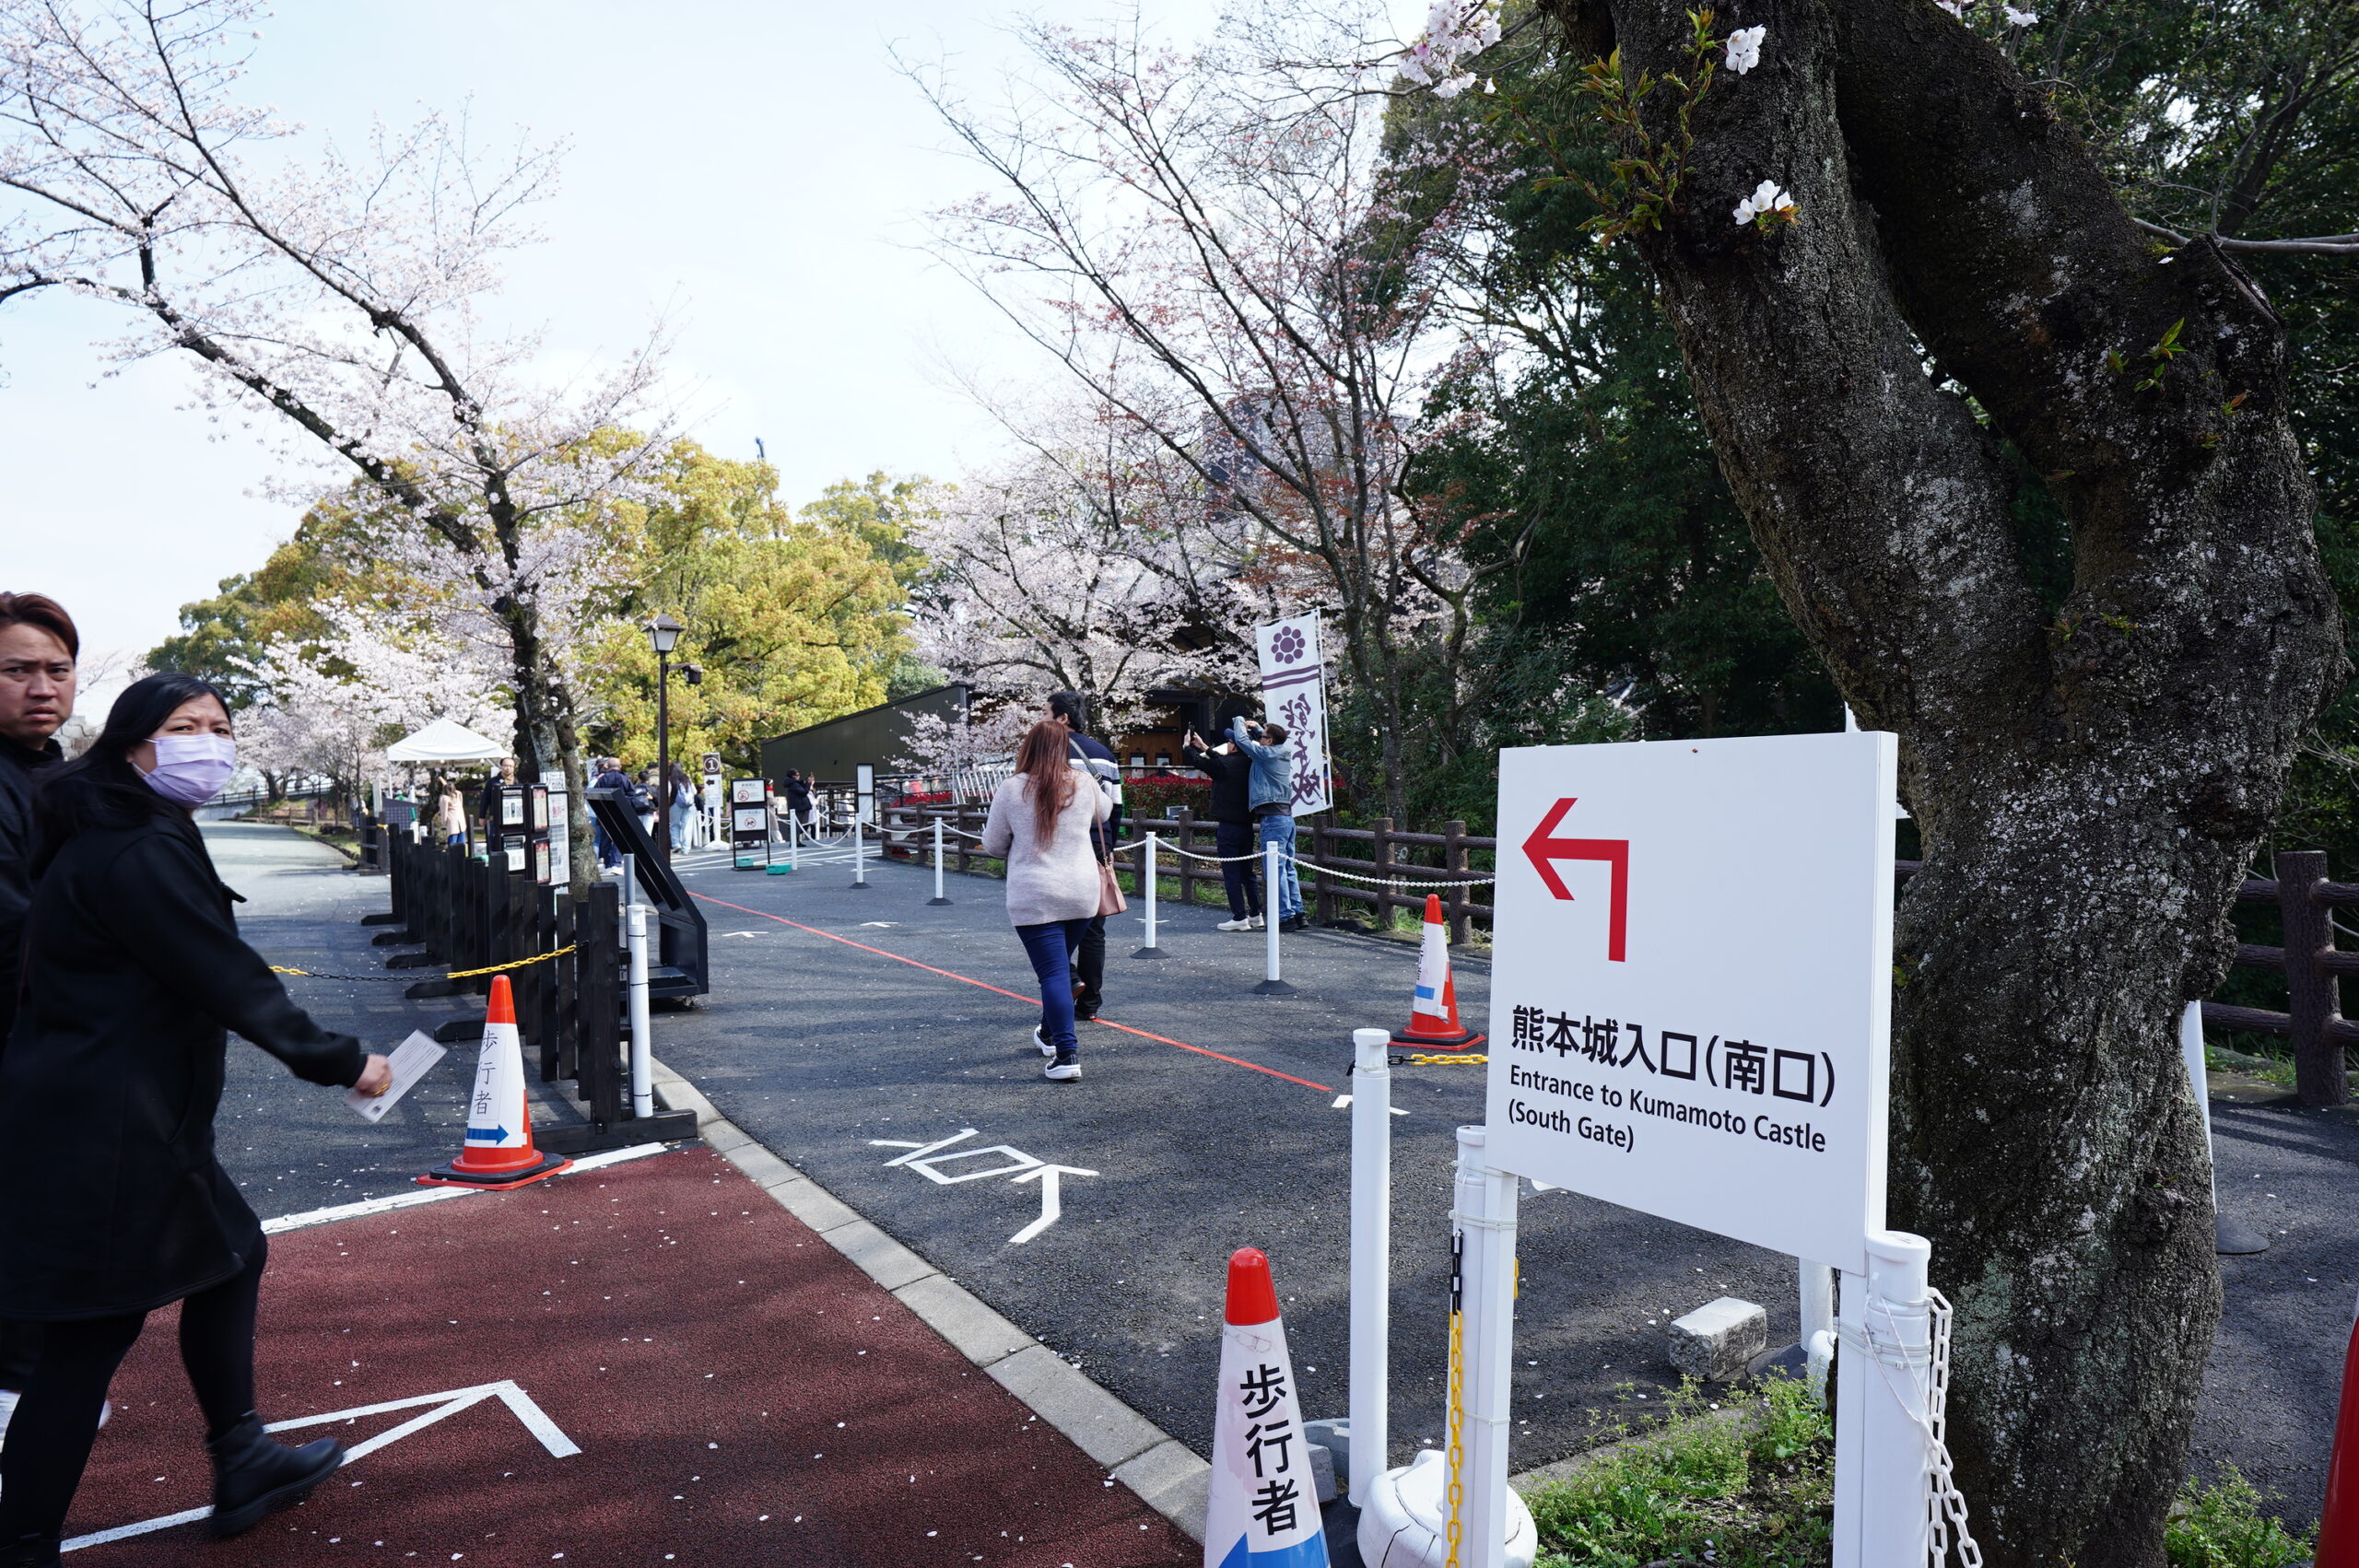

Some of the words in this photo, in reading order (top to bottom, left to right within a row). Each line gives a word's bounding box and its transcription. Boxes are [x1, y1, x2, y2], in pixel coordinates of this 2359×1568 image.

[474, 1029, 499, 1116] 歩行者
[1511, 1004, 1836, 1108] 熊本城入口(南口)
[1508, 1098, 1571, 1134] (South
[1578, 1116, 1634, 1153] Gate)
[1510, 1064, 1594, 1102] Entrance
[1600, 1084, 1623, 1108] to
[1629, 1088, 1746, 1135] Kumamoto
[1754, 1115, 1826, 1153] Castle
[1239, 1363, 1299, 1536] 歩行者
